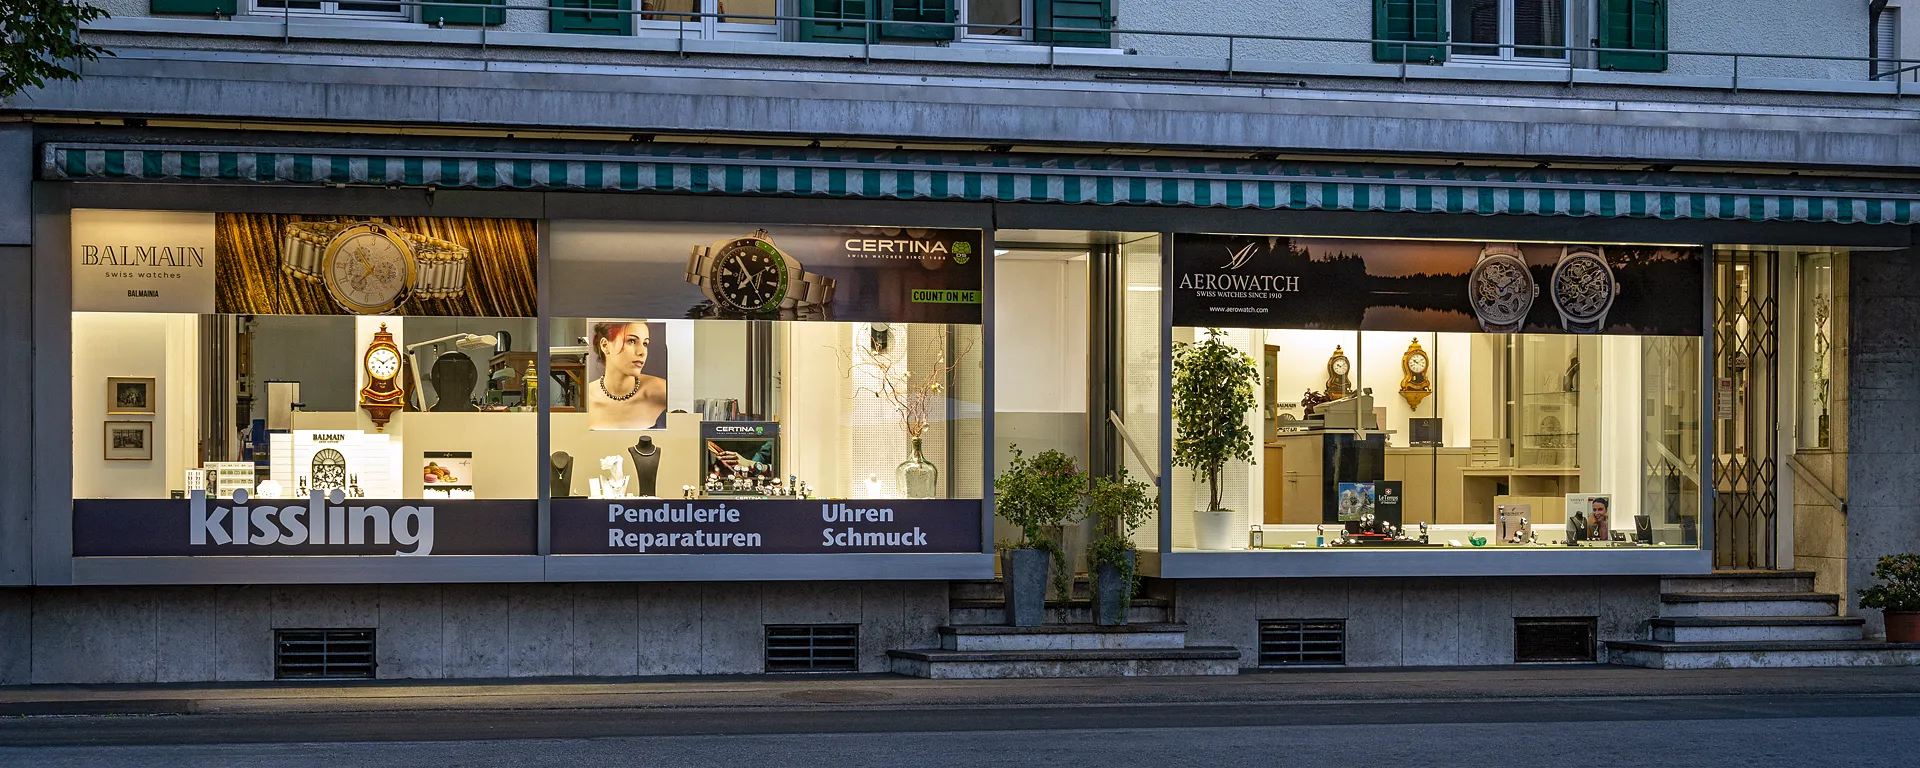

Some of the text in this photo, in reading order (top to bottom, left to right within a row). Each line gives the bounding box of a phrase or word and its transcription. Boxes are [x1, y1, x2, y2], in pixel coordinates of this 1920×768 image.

[844, 238, 949, 254] CERTINA
[81, 244, 205, 268] BALMAIN
[105, 270, 181, 279] swiss watches
[1178, 272, 1300, 292] AEROWATCH
[127, 289, 159, 298] BALMAINIA
[913, 290, 975, 303] COUNT ON ME
[1196, 290, 1216, 298] SWISS
[1217, 291, 1248, 299] WATCHES
[1268, 292, 1283, 300] 1910
[1209, 306, 1269, 314] www.aerowatch.com
[312, 433, 345, 441] BALMAIN
[608, 503, 740, 523] Pendulerie
[821, 504, 895, 523] Uhren
[190, 488, 435, 556] kissling
[608, 528, 762, 553] Reparaturen
[821, 527, 928, 546] Schmuck
